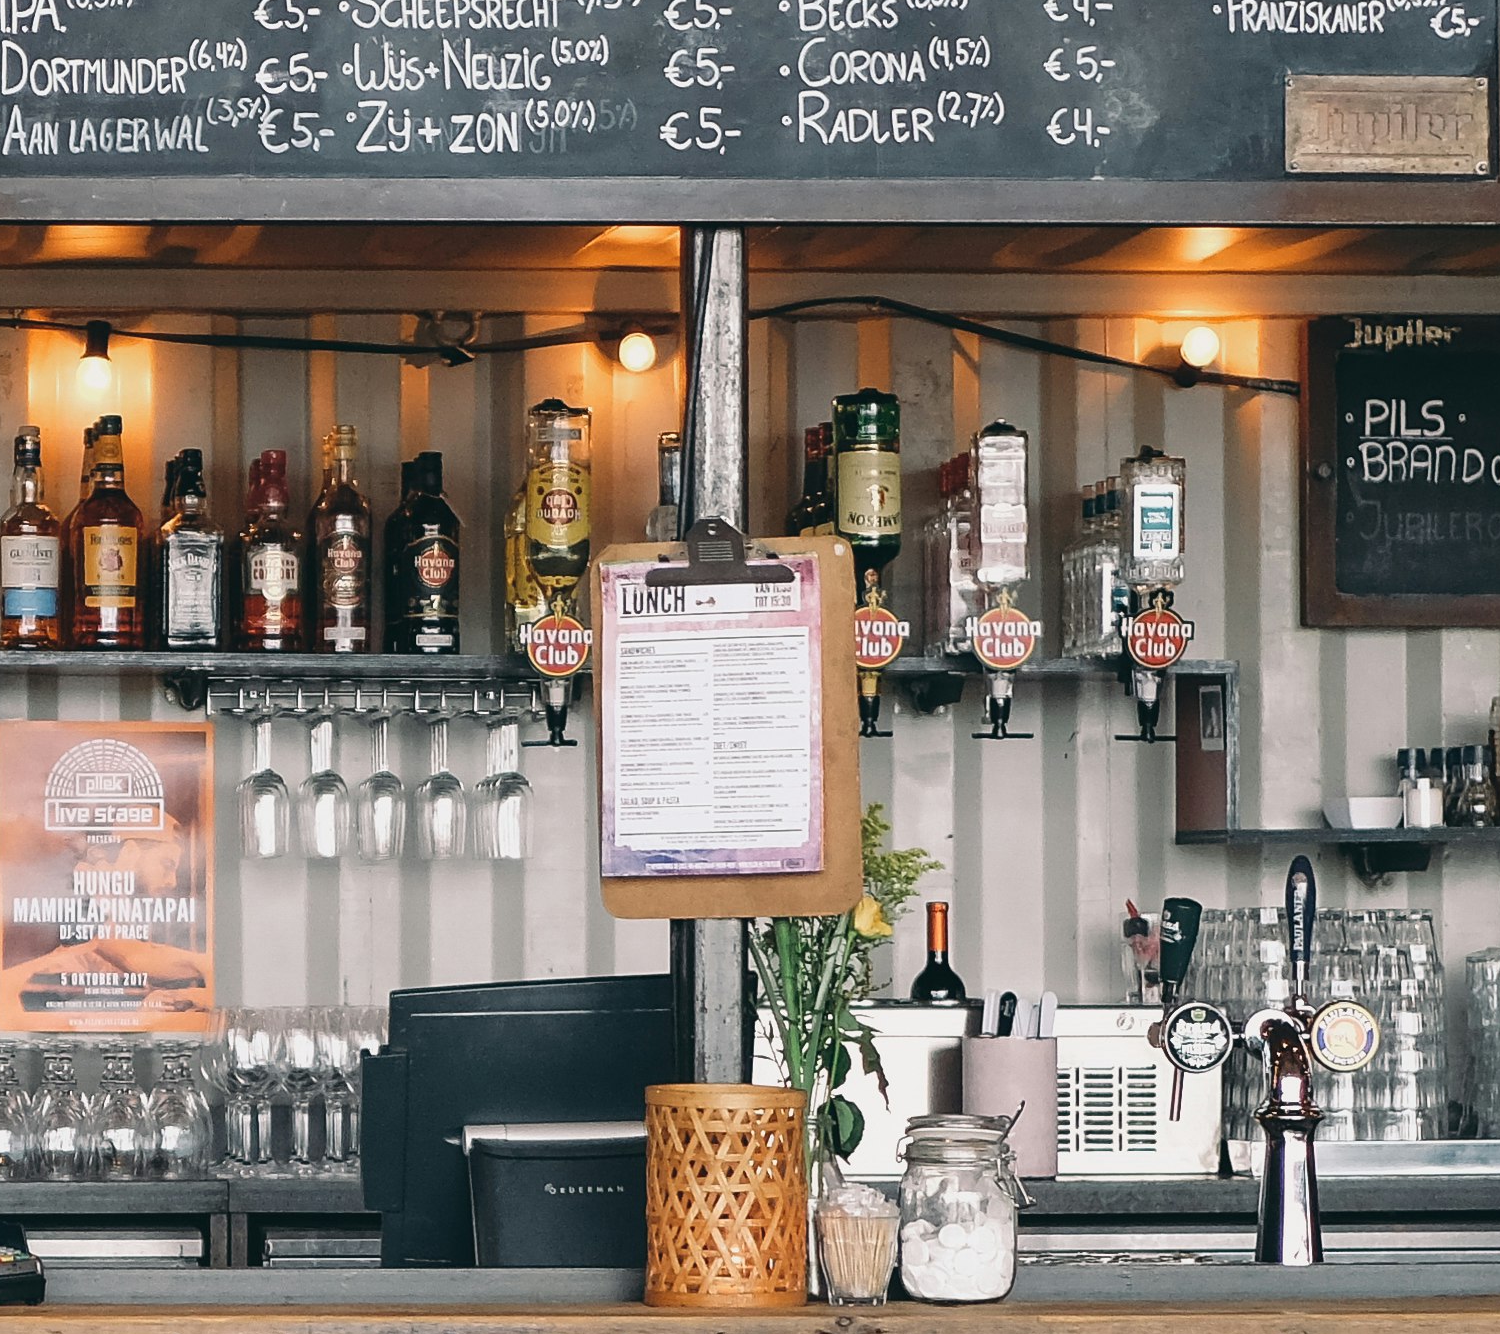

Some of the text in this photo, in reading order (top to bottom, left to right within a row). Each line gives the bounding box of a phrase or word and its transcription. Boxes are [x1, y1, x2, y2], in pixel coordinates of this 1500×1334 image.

[0, 39, 188, 96] DORTMUNDER
[797, 36, 927, 88] CORONA
[797, 89, 936, 145] RADLER
[1313, 102, 1475, 149] Jupiler
[1, 104, 61, 156] AAN
[1343, 317, 1462, 353] Jupiler
[1364, 398, 1446, 438] PILS
[1357, 440, 1486, 484] BRAND
[414, 555, 456, 568] Havana
[422, 566, 447, 579] Club
[621, 585, 686, 616] LUNCH
[519, 622, 592, 645] Havana
[855, 620, 911, 639] vana
[965, 616, 1042, 638] Havana
[1121, 616, 1193, 638] Havana
[534, 645, 579, 665] Club
[981, 636, 1026, 658] Club
[1134, 636, 1177, 658] Club
[53, 801, 154, 825] live stage
[73, 870, 136, 896] HUNGU
[12, 897, 197, 924] MAMIHLAPINATAPAI
[59, 924, 150, 941] DJ-SET BY PRACE
[60, 972, 149, 986] 5 OKTOBER 2017
